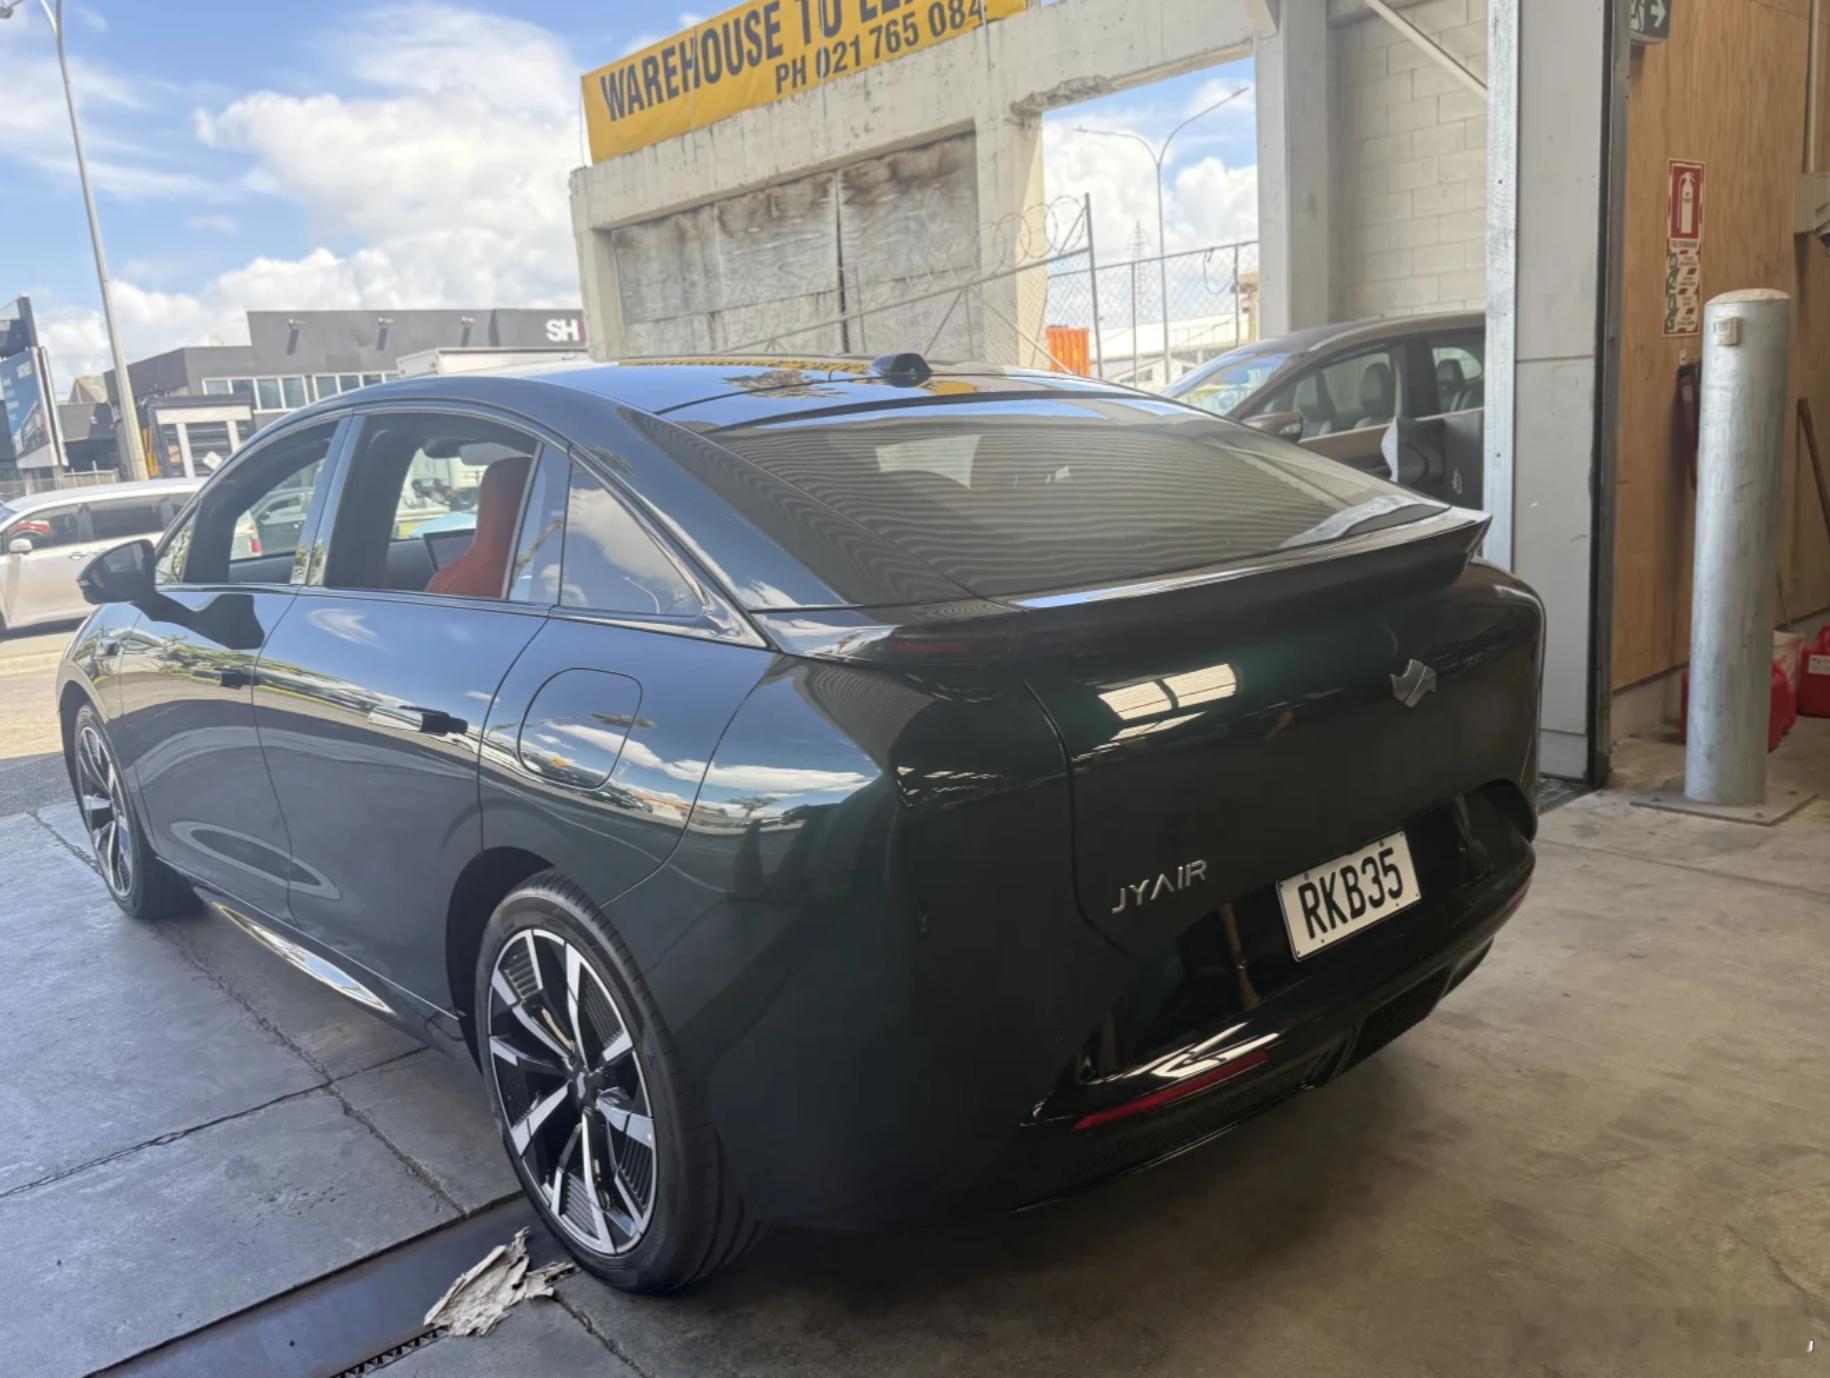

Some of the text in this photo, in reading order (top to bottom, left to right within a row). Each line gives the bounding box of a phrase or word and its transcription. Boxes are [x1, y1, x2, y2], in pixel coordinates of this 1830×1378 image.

[601, 0, 842, 122] WAREHOUSE TO
[776, 55, 807, 94] PH
[816, 34, 860, 79] 021
[869, 11, 919, 59] 765
[1298, 847, 1404, 939] RKB35
